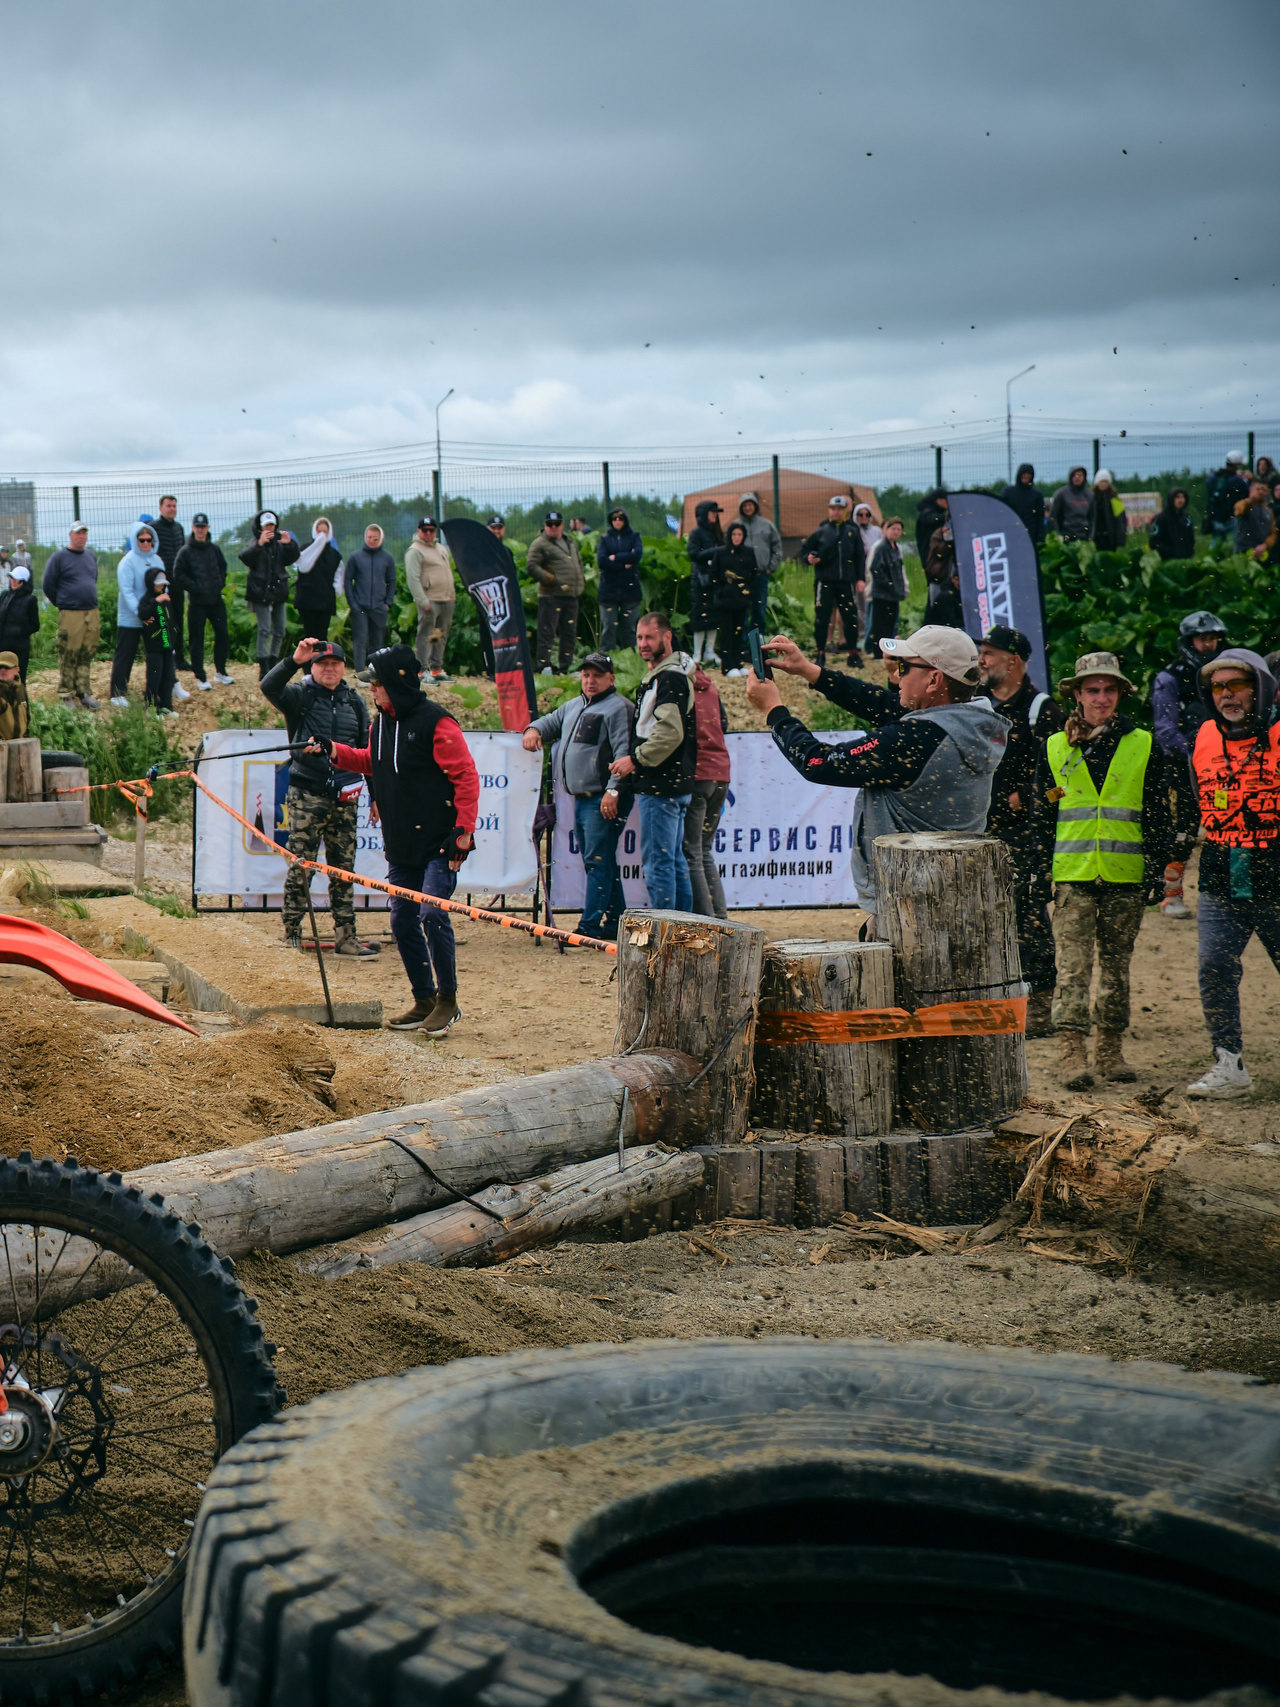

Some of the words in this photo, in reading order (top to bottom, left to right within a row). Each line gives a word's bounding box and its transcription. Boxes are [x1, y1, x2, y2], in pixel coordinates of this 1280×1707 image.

[849, 738, 880, 756] ROTAX
[732, 859, 833, 879] газификация
[622, 1366, 1136, 1426] DUNLOP
